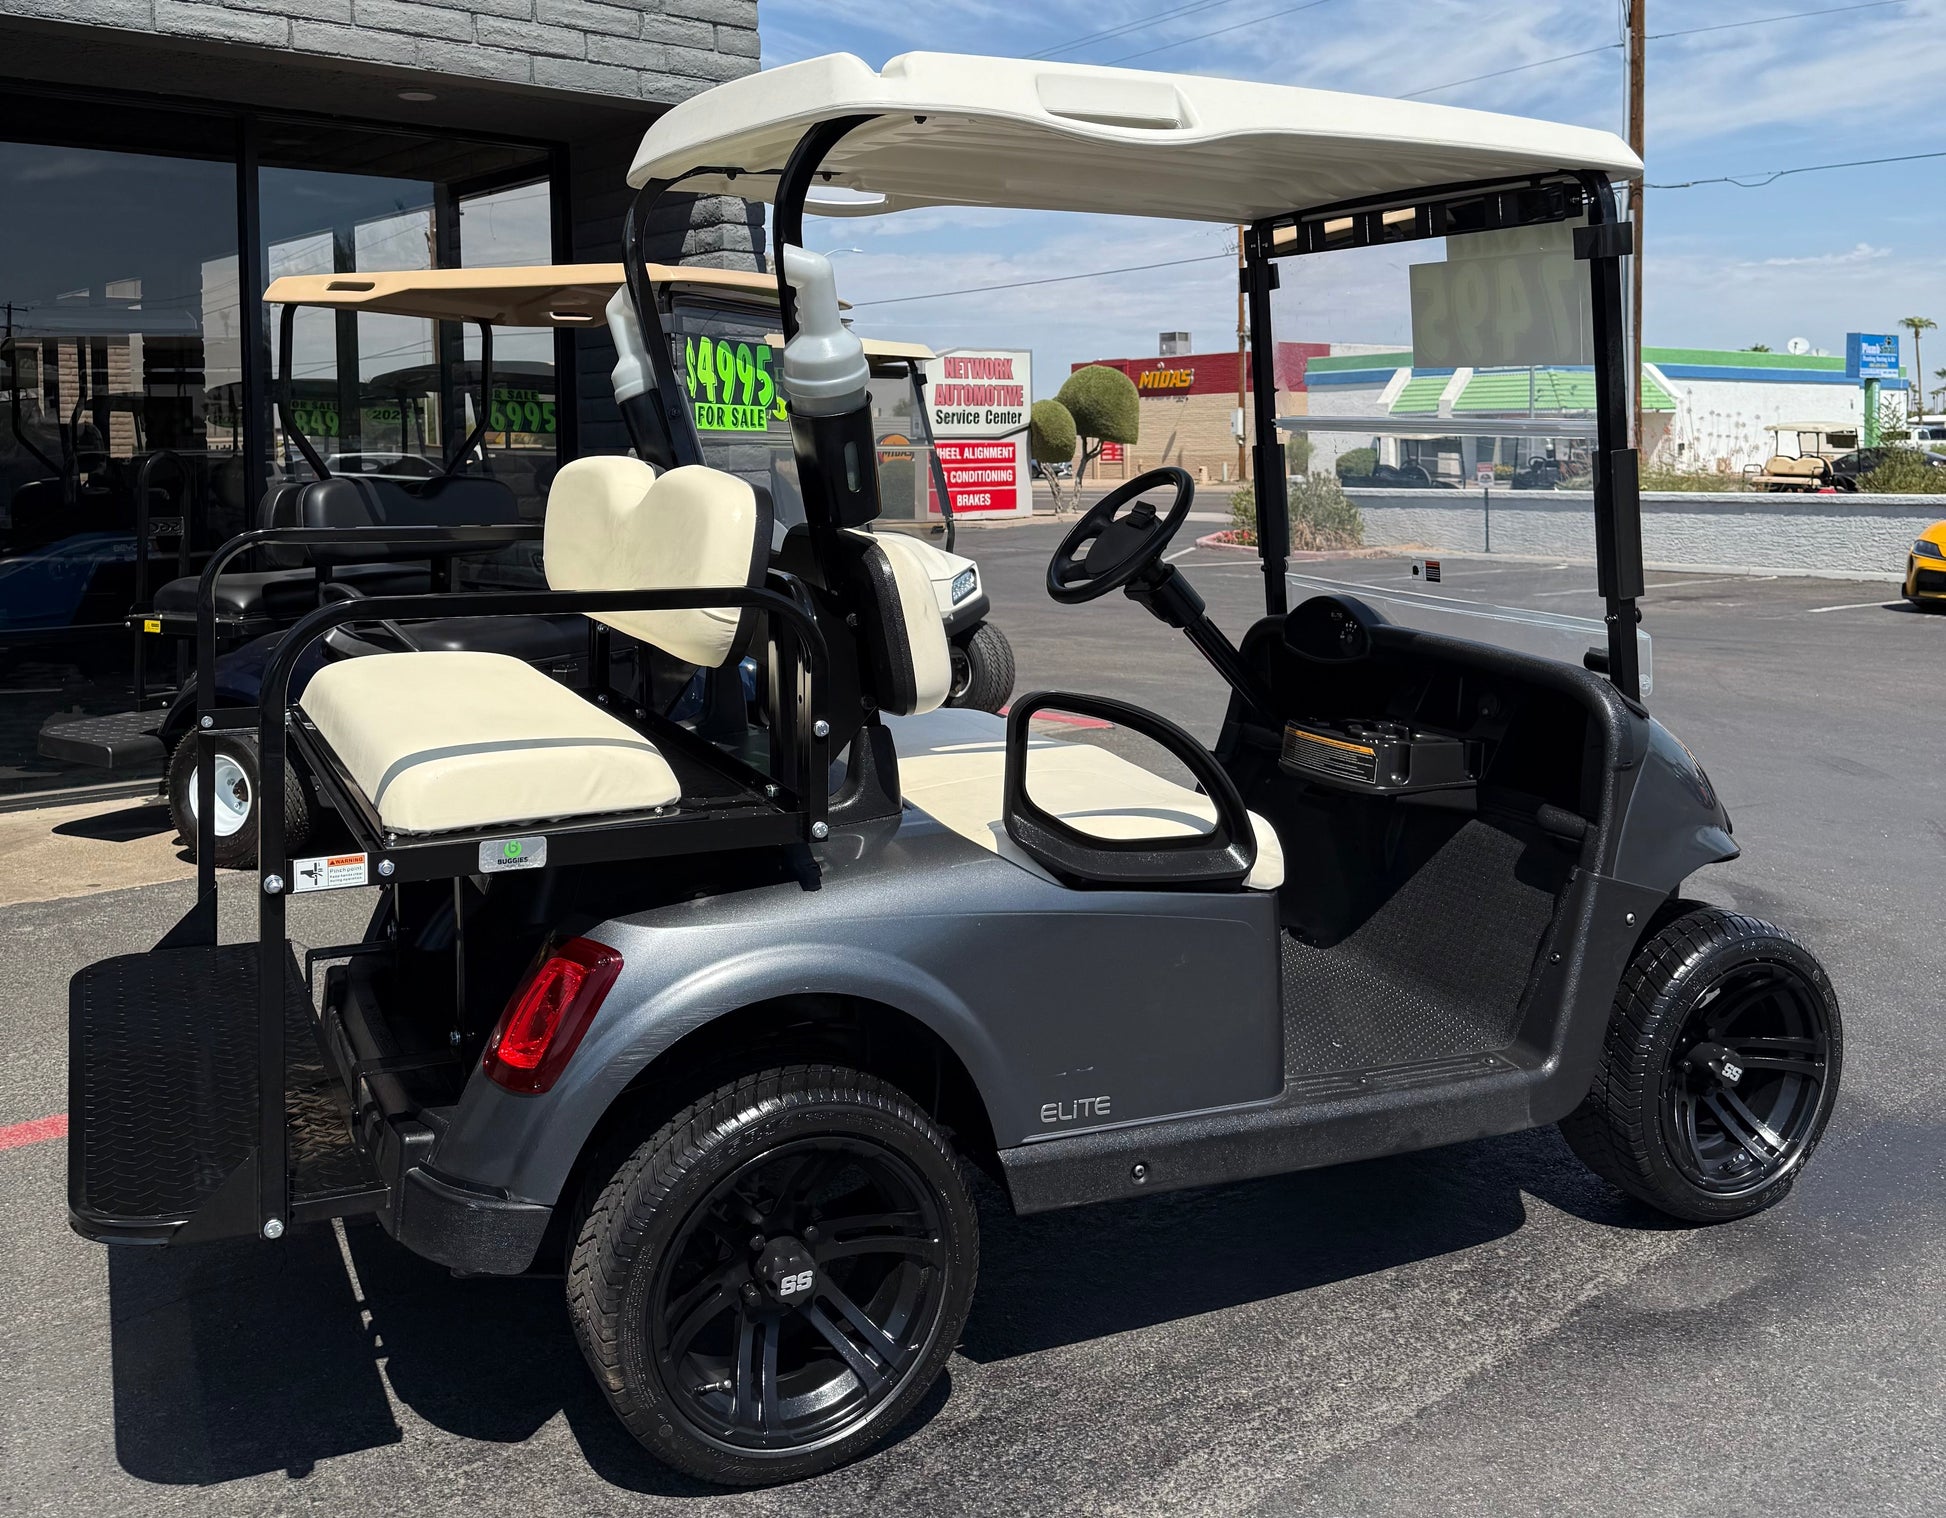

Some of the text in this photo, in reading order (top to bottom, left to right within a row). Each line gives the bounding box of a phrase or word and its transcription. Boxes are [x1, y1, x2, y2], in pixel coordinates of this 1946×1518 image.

[686, 336, 774, 408] $4995
[944, 357, 1014, 380] NETWORK
[1139, 368, 1194, 388] MIDAS
[934, 384, 1024, 407] AUTOMOTIVE
[294, 410, 339, 436] 849
[372, 409, 406, 420] 202
[490, 400, 556, 432] 6995
[698, 405, 725, 428] FOR
[732, 407, 765, 429] SALE
[935, 409, 1022, 424] Service Center
[963, 446, 1014, 459] ALIGNMENT
[950, 469, 1013, 483] CONDITIONING
[956, 493, 991, 506] BRAKES
[497, 856, 529, 865] BUGGIES
[1721, 1062, 1743, 1082] SS
[780, 1270, 814, 1296] SS
